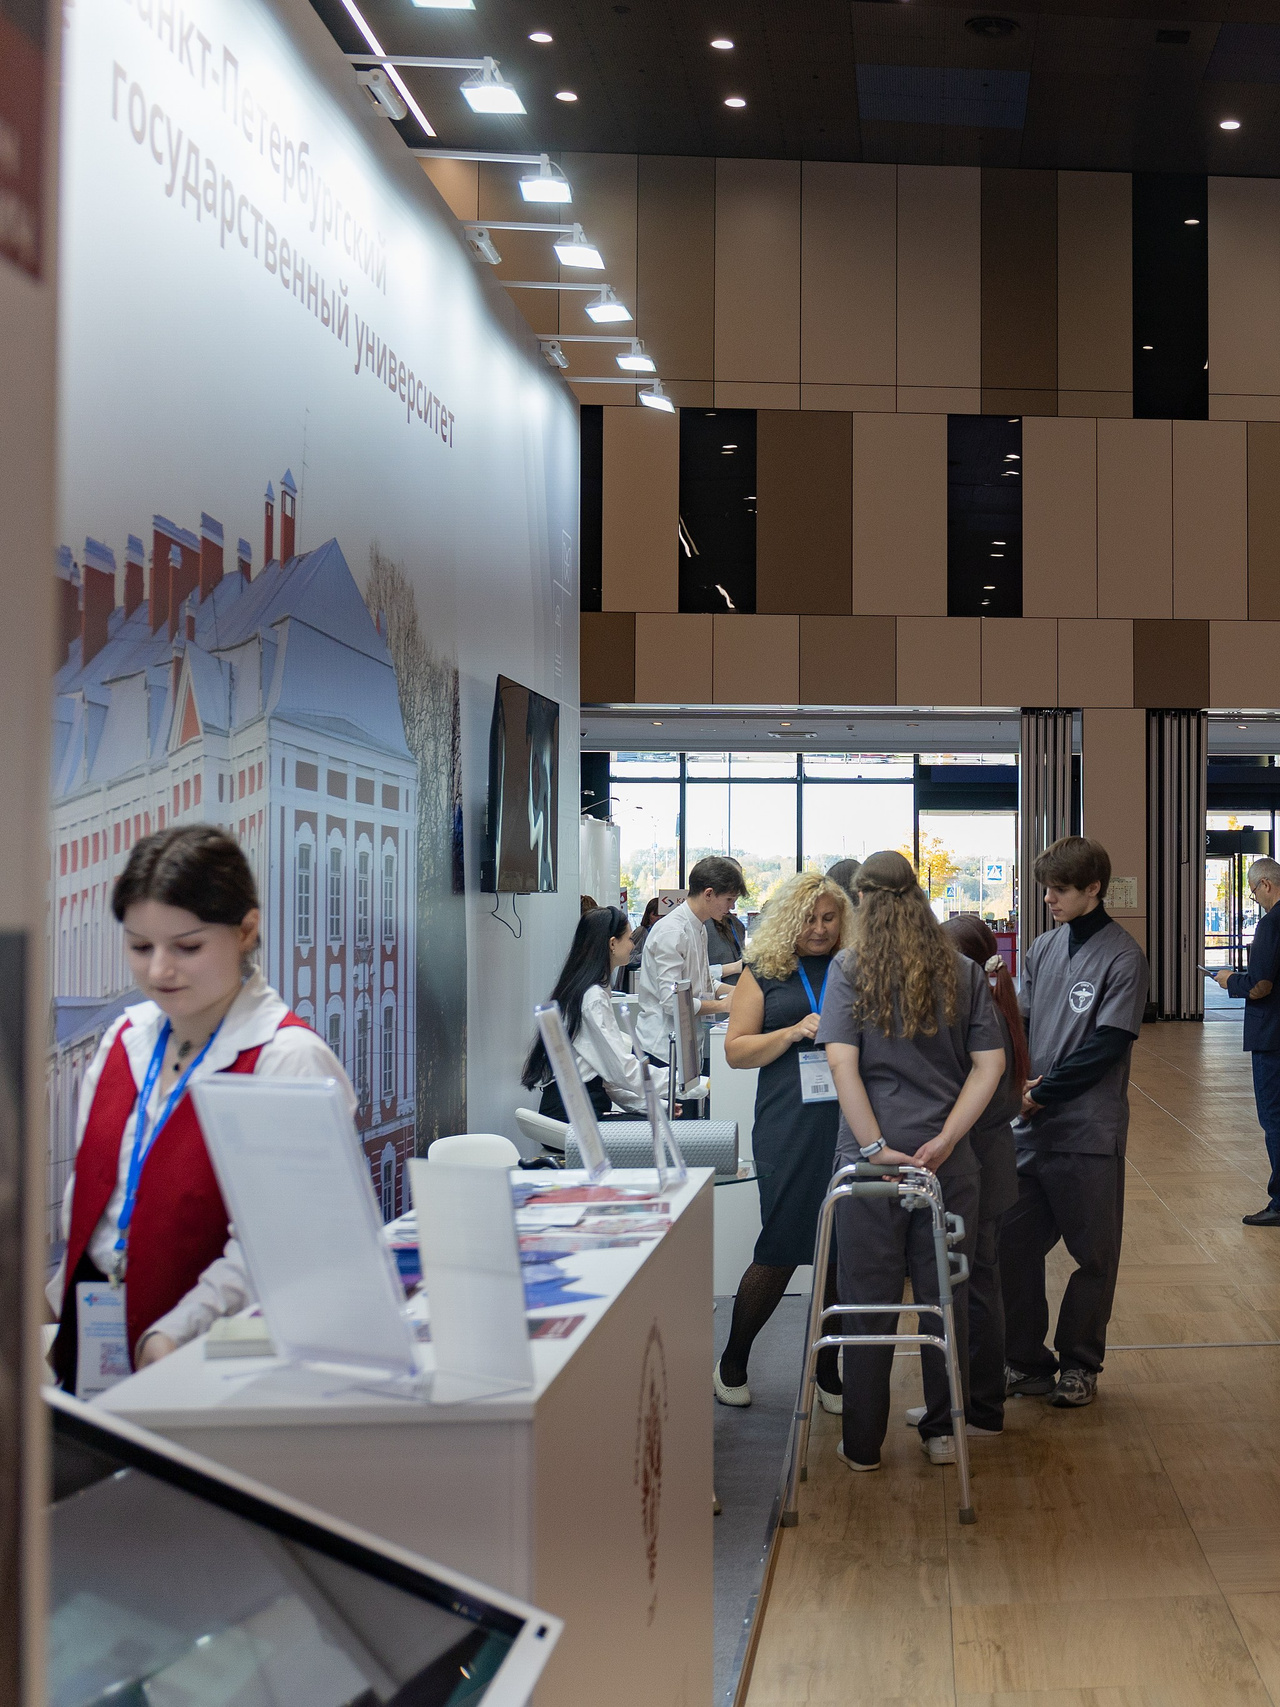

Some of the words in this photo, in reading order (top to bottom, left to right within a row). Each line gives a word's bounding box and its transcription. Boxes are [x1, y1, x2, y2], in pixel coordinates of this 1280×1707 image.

[111, 60, 349, 347] государственный
[354, 312, 455, 448] университет
[126, 0, 388, 296] анкт-Петербургский
